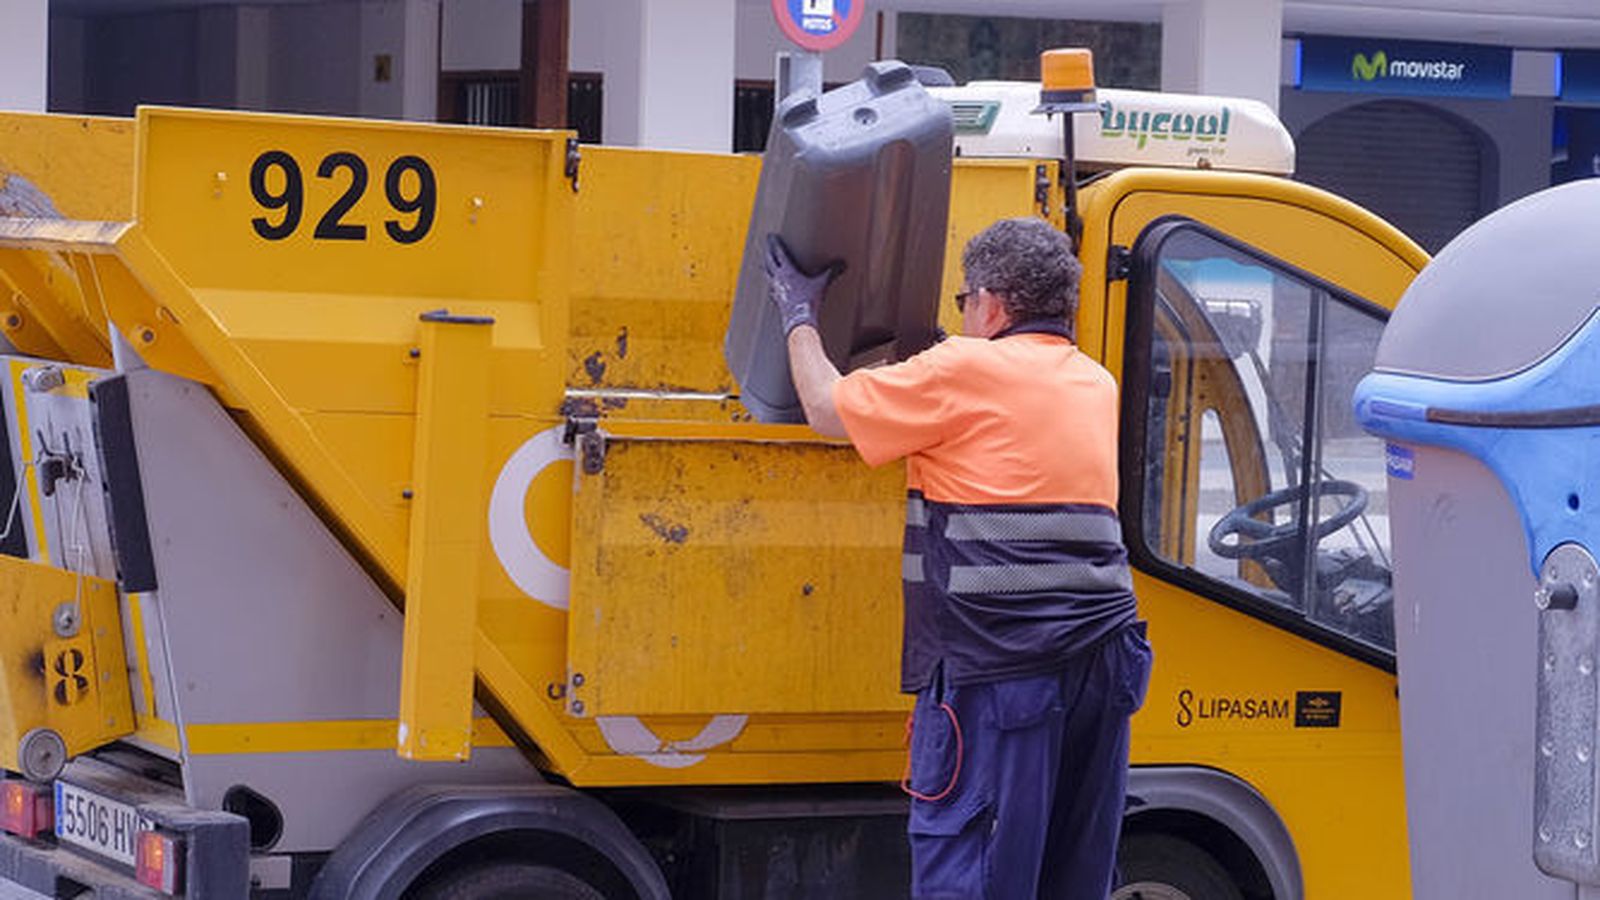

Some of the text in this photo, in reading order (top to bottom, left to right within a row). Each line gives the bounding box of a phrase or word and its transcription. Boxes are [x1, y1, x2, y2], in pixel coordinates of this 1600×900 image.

[1390, 60, 1465, 79] movistar
[1101, 100, 1230, 150] bycool
[249, 150, 437, 244] 929
[1199, 698, 1290, 719] LIPASAM
[65, 792, 109, 847] 5506
